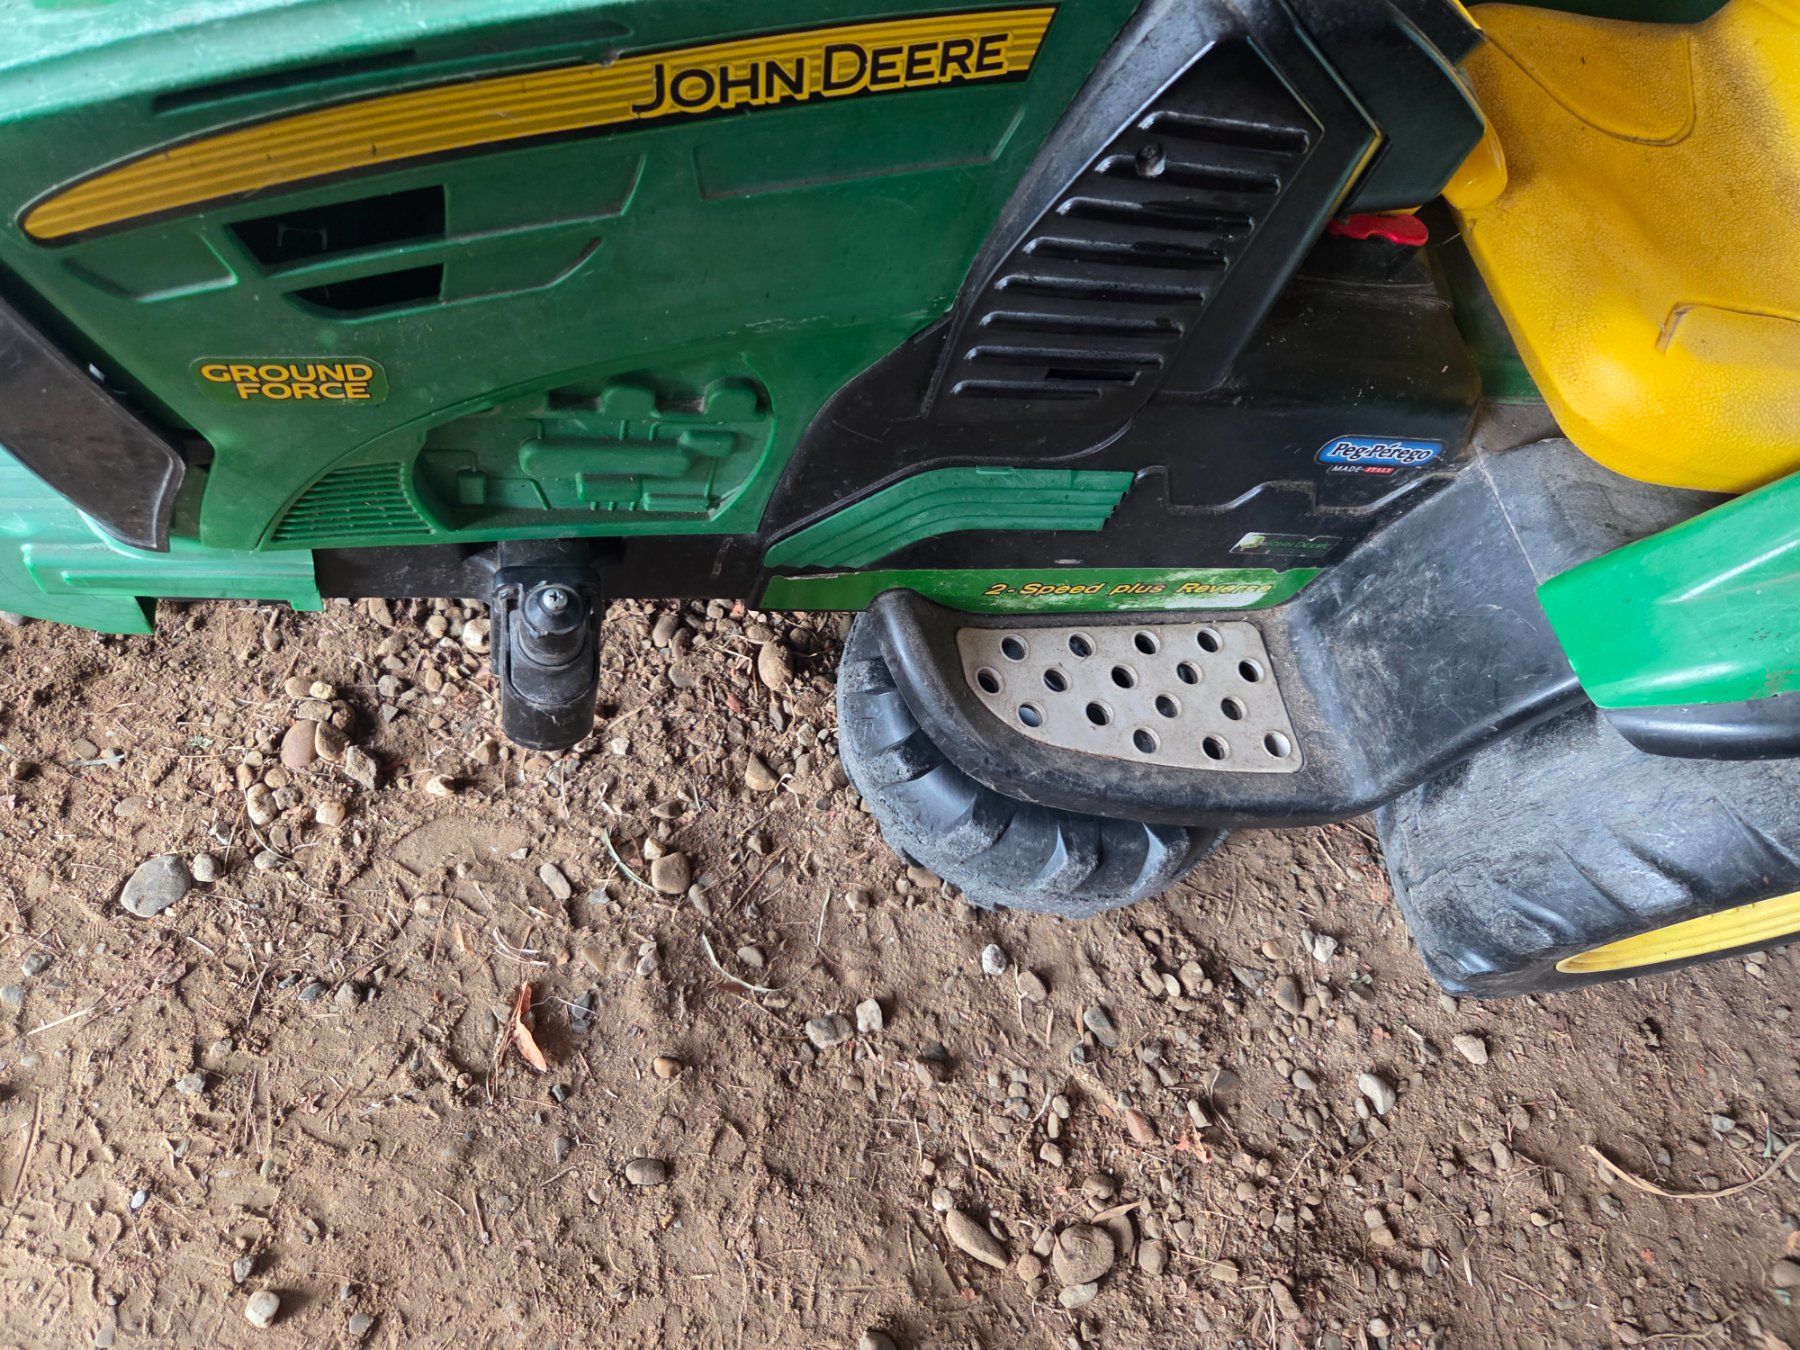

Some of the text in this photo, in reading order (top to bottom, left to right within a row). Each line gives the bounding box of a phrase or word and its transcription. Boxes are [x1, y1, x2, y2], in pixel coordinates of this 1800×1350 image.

[631, 32, 1013, 118] JOHN DEERE
[200, 363, 374, 383] GROUND
[236, 381, 371, 400] FORCE
[1107, 582, 1165, 597] plus
[1175, 582, 1273, 596] Reverse
